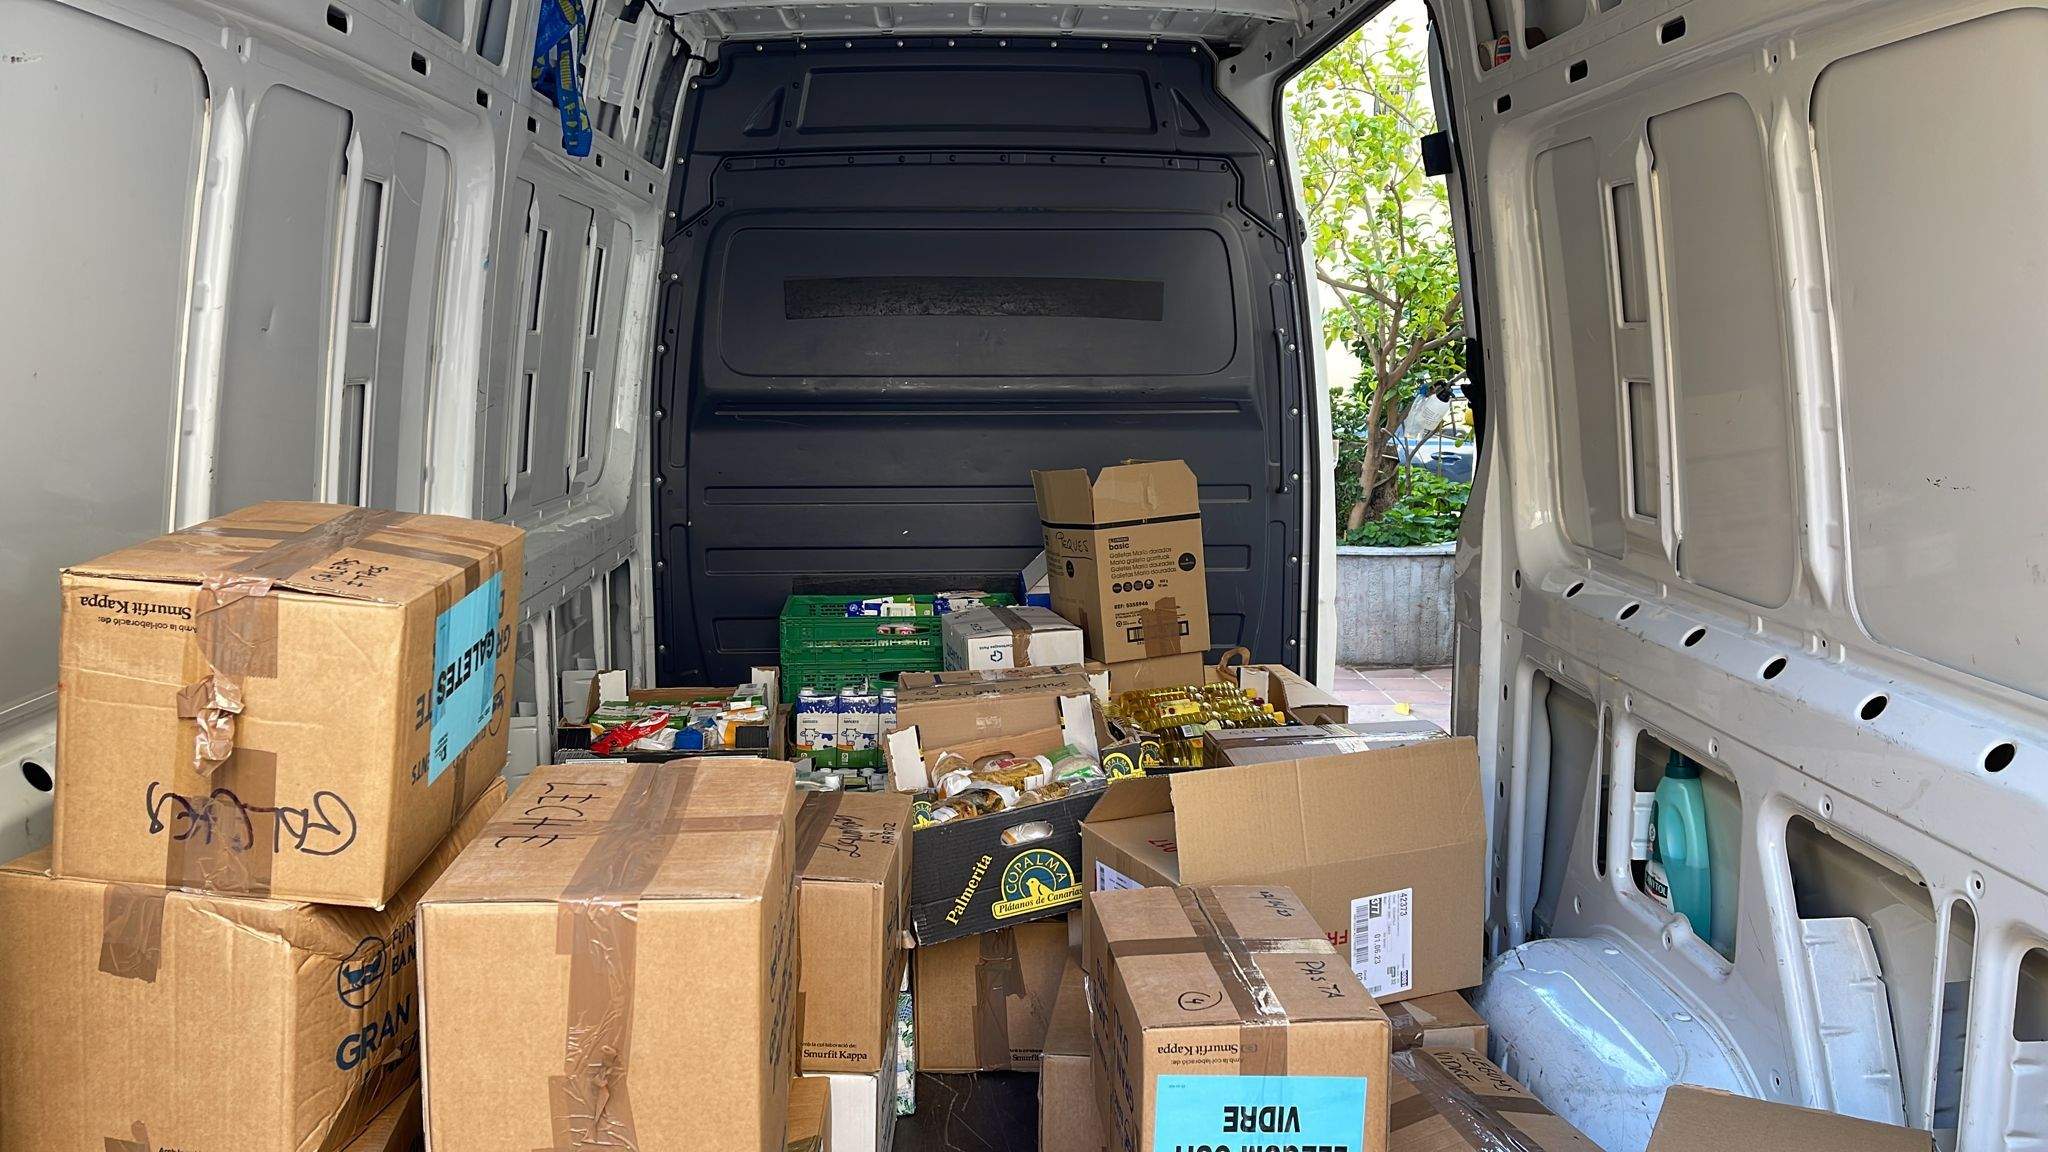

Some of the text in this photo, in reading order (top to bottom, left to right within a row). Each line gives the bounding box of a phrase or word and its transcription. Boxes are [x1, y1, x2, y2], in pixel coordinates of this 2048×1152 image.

[80, 594, 192, 620] Smurfit Kappa
[437, 628, 496, 706] GALETES
[495, 783, 607, 848] LECHE
[881, 822, 897, 846] ARROZ
[1006, 854, 1068, 894] COPALMA
[944, 853, 993, 927] Palmerita
[998, 886, 1083, 914] Plátanos de Canarias
[1371, 898, 1381, 915] 377
[1399, 892, 1408, 917] 42373
[1374, 933, 1382, 965] 01.06.23
[336, 994, 412, 1070] GRAN
[803, 1049, 868, 1062] Smurfit Kappa
[1157, 1043, 1239, 1057] Smurfit Kappa
[1223, 1106, 1301, 1133] VIDRE
